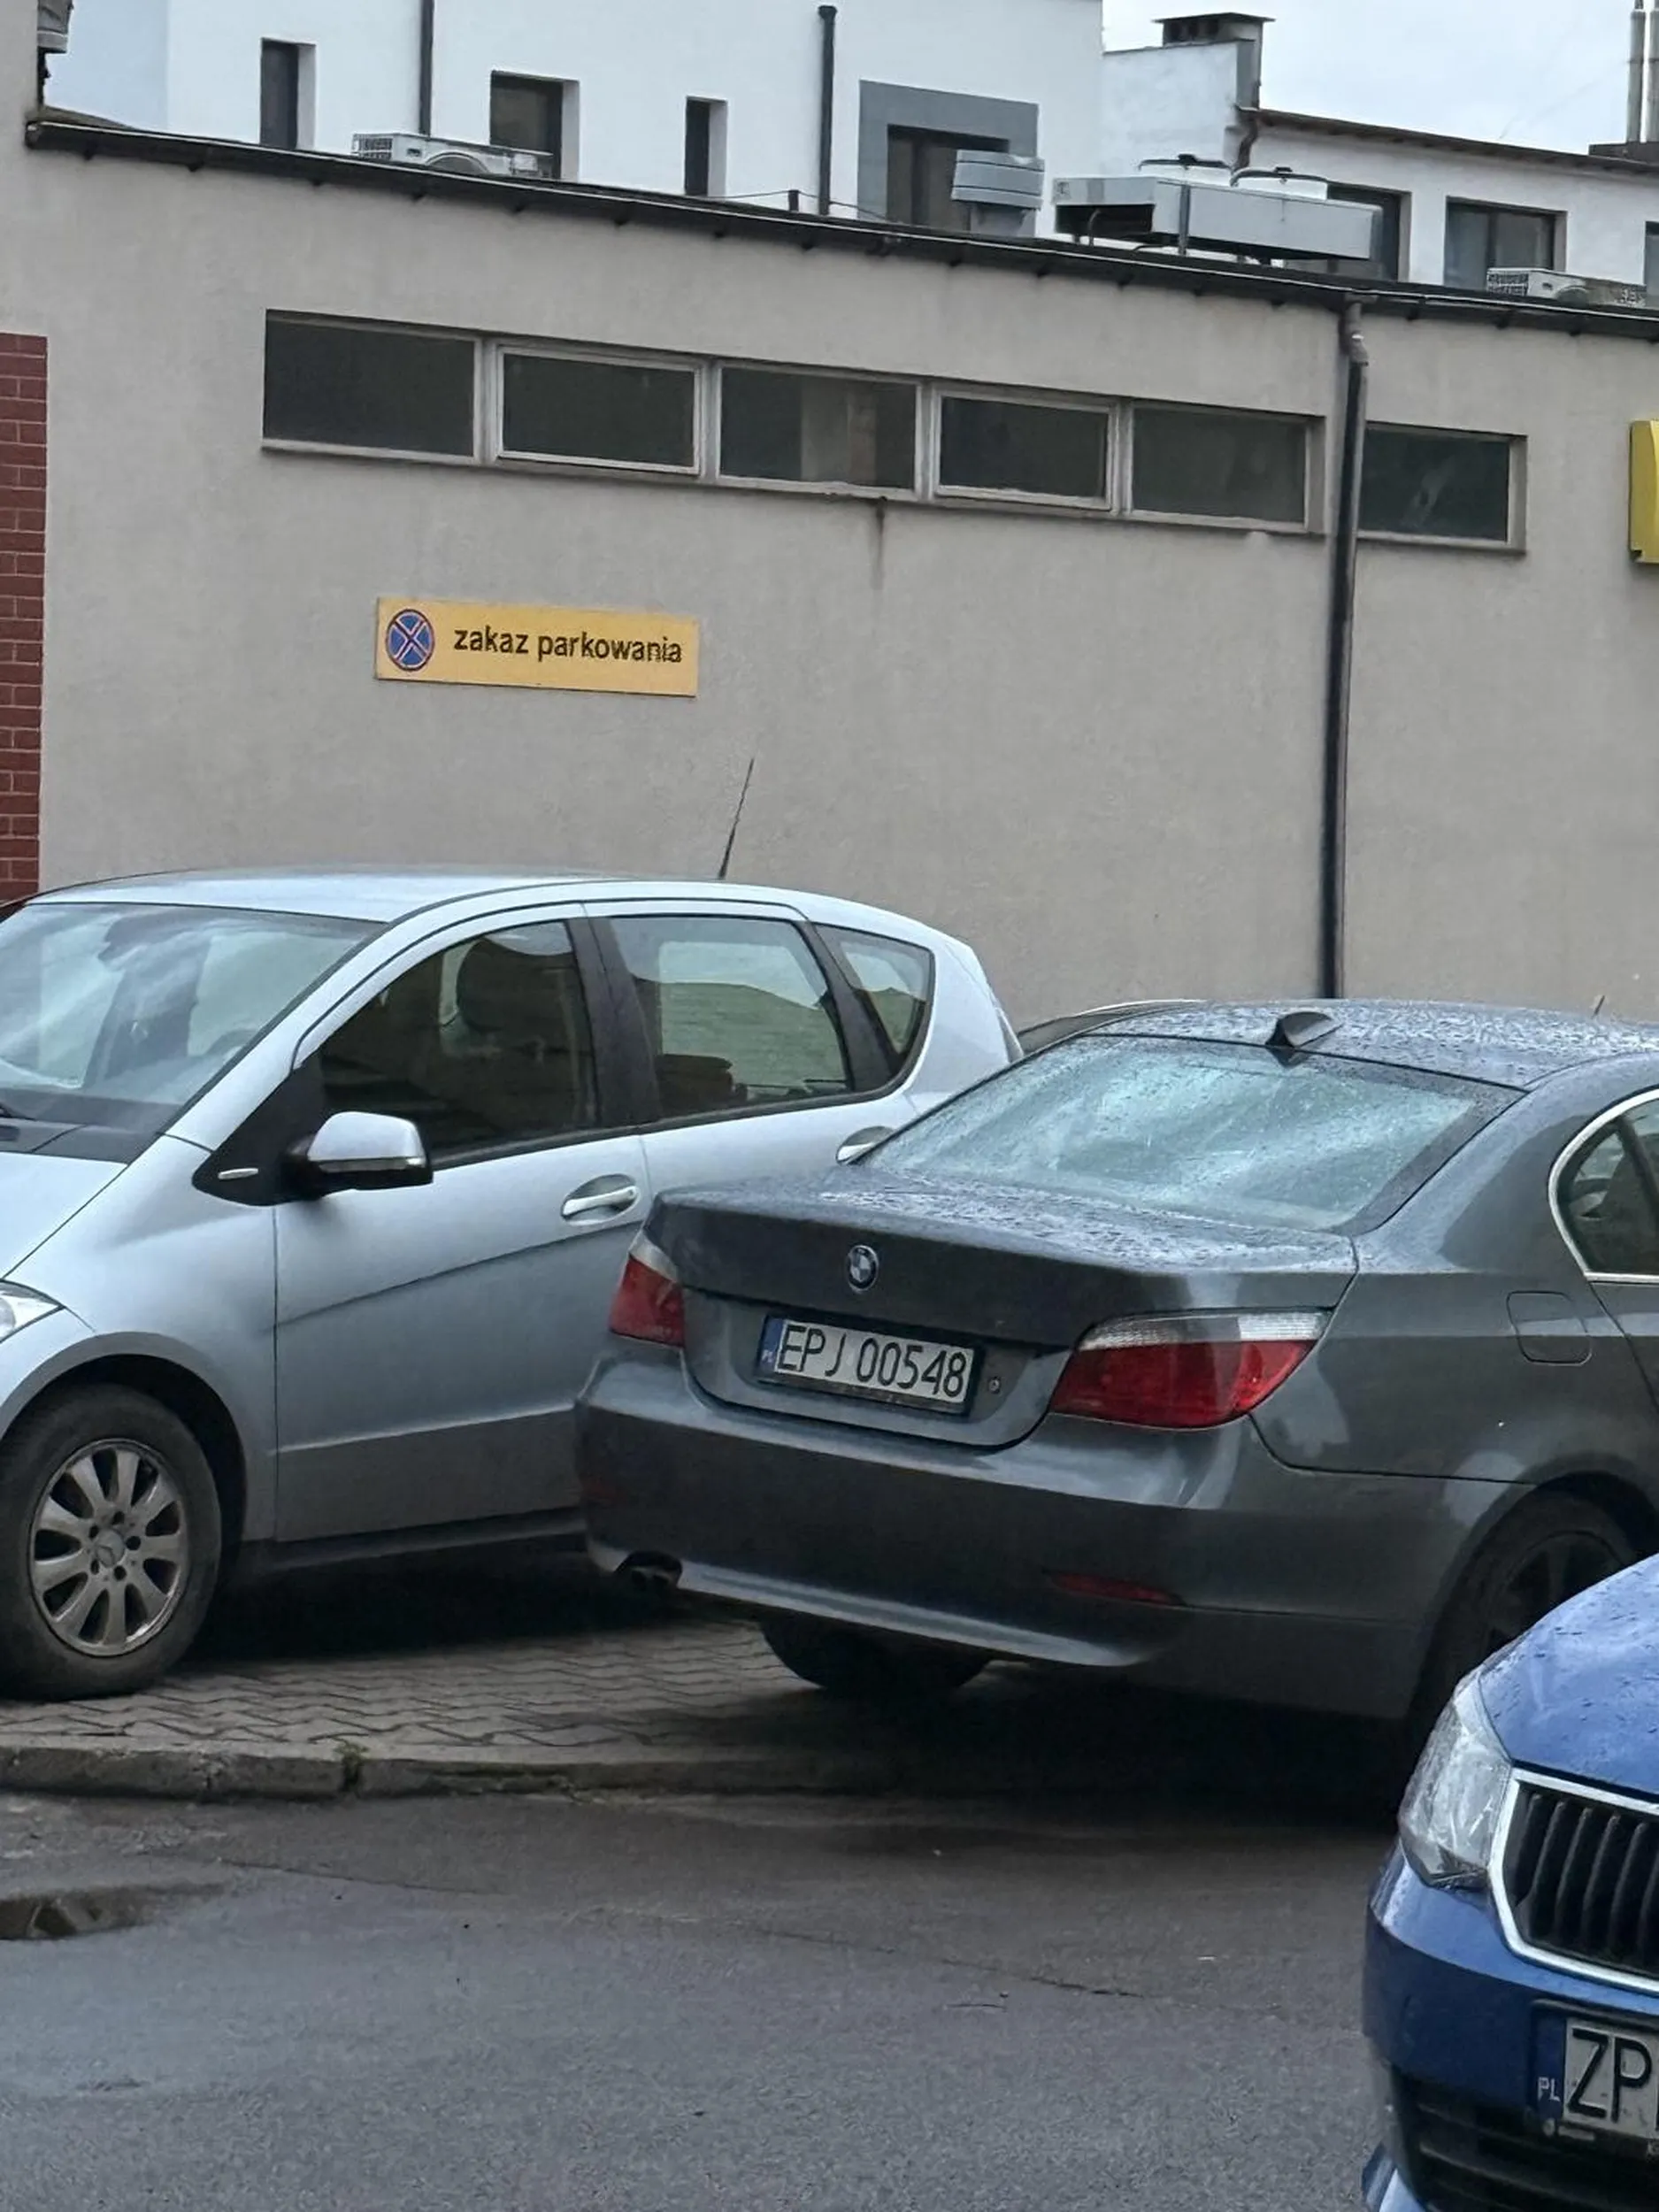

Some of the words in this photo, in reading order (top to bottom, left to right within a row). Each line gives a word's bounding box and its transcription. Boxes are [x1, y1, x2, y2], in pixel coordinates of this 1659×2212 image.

[453, 626, 529, 654] zakaz
[537, 631, 682, 662] parkowania
[778, 1326, 847, 1377] EPJ
[856, 1337, 966, 1397] 00548
[1537, 2077, 1560, 2101] PL
[1567, 2027, 1659, 2131] ZP
